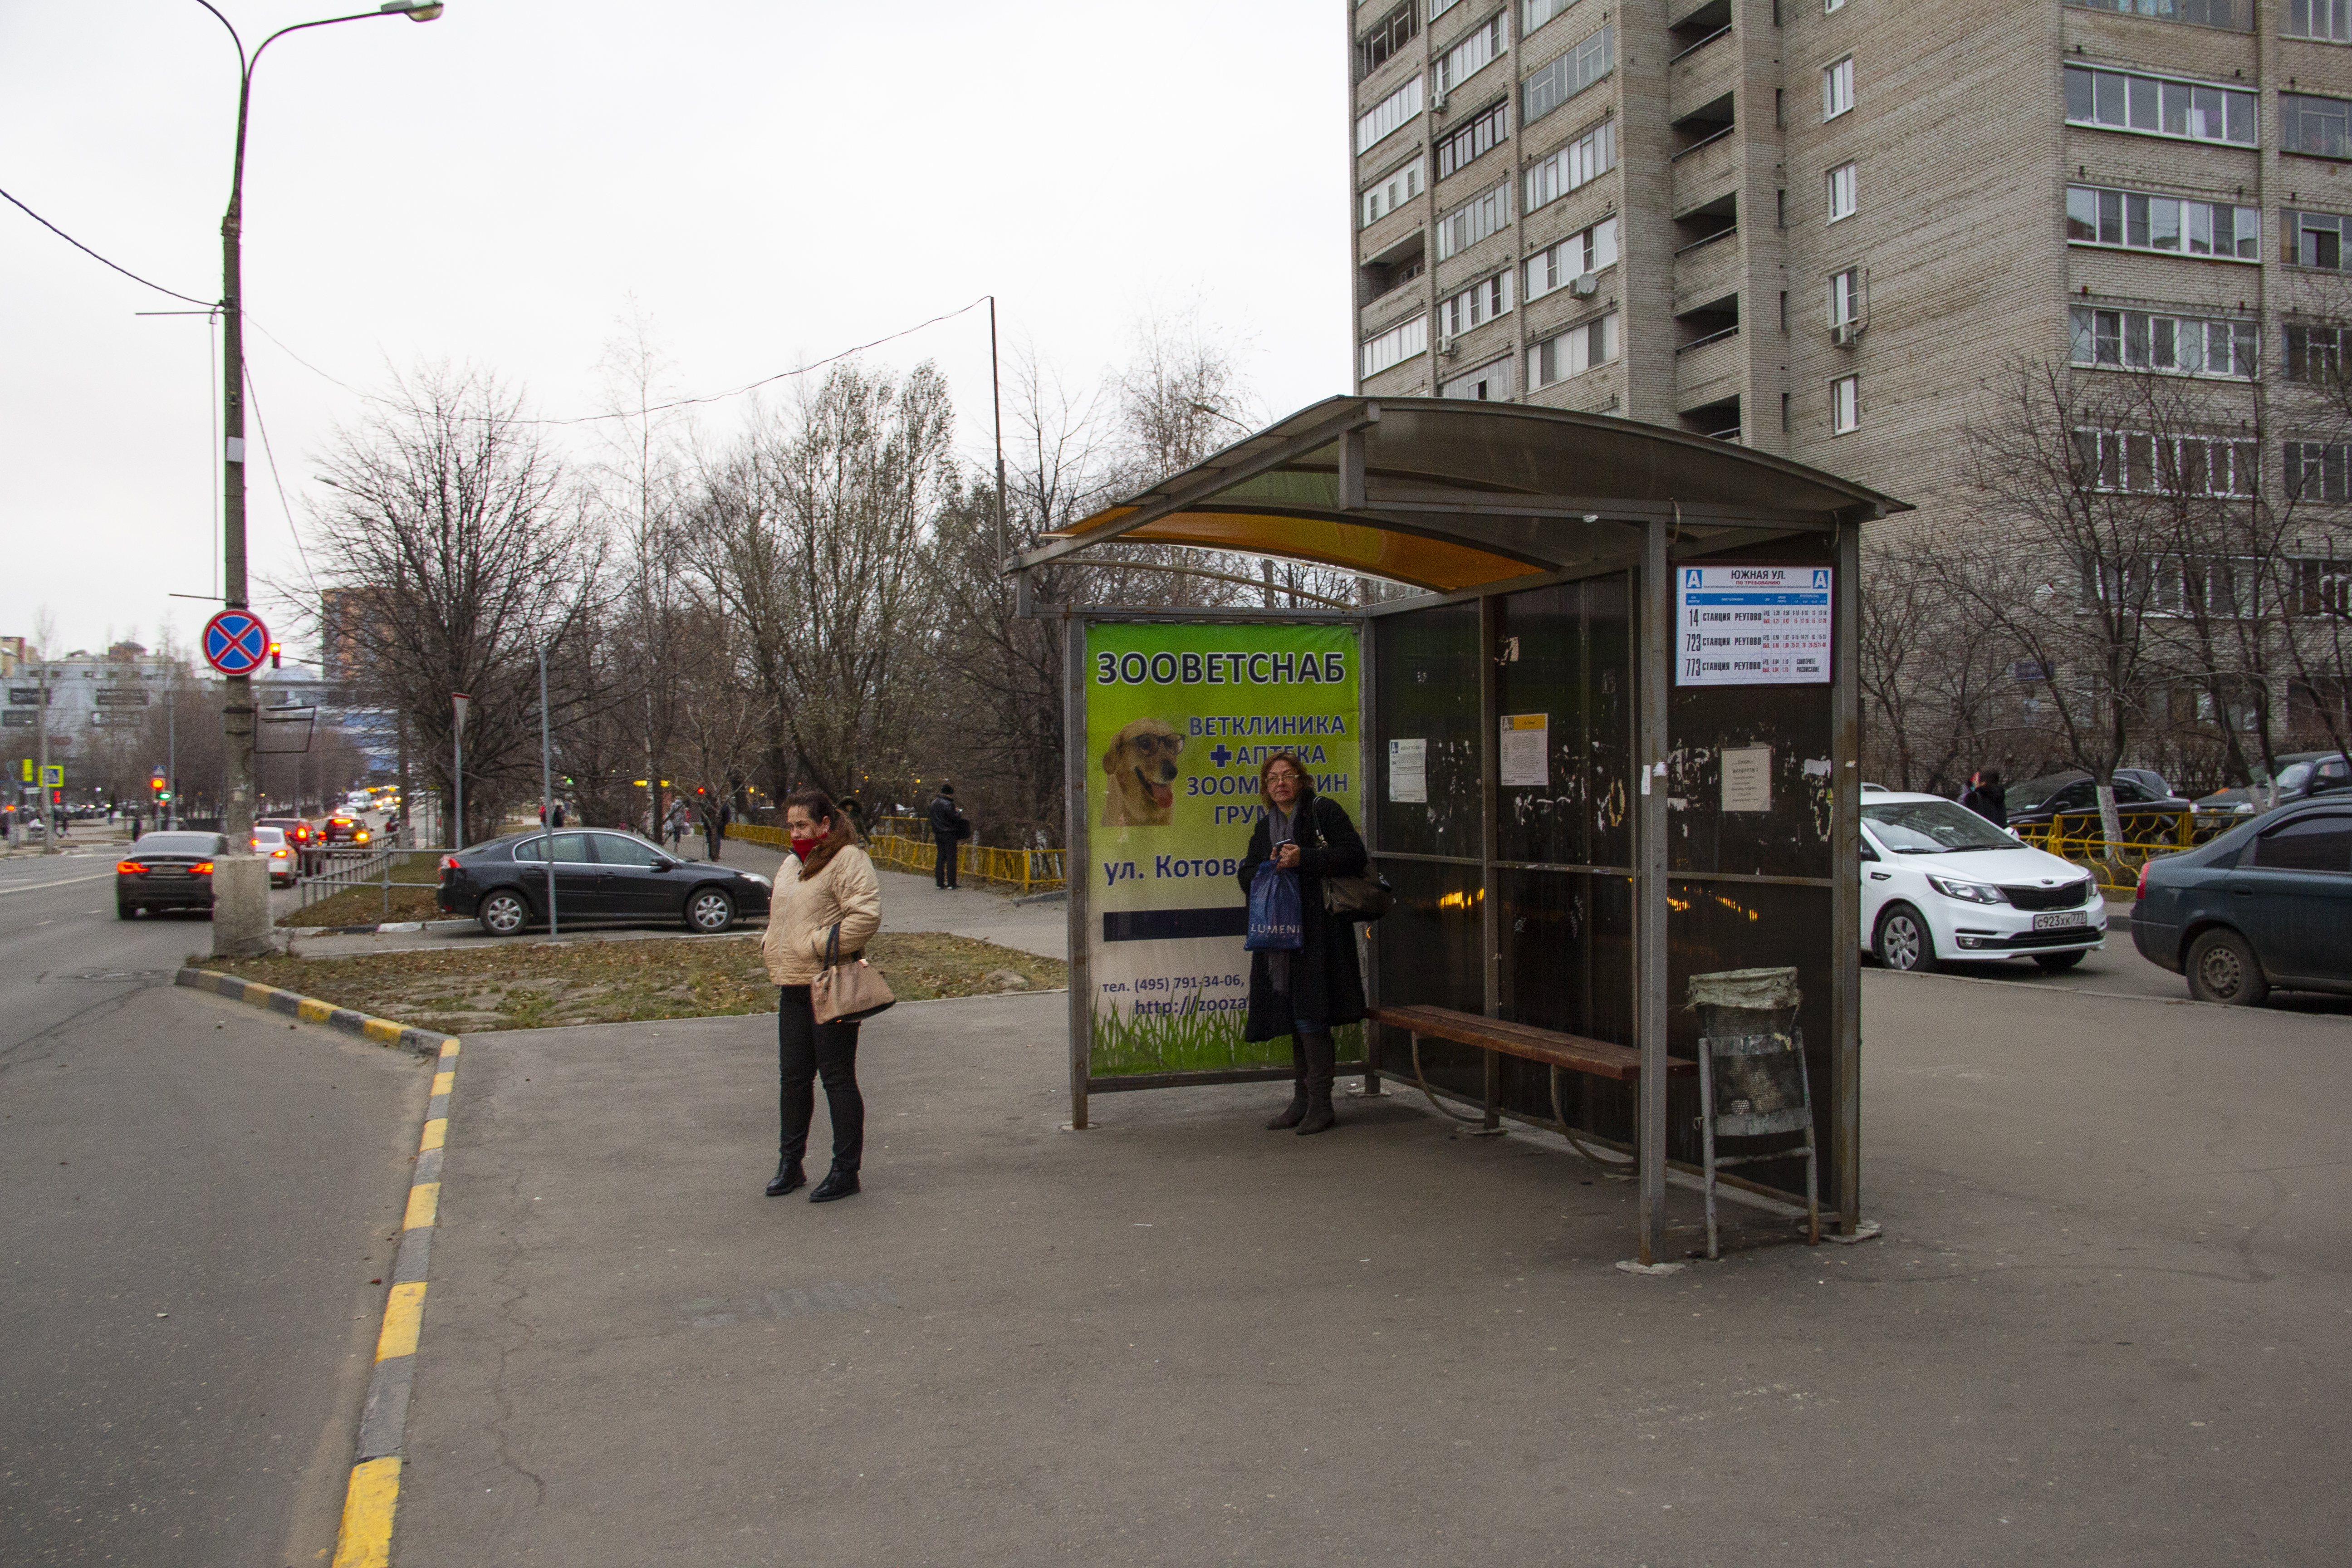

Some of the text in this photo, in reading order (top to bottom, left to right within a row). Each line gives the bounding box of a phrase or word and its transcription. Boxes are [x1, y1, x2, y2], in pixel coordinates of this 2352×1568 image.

[1731, 570, 1786, 579] ЮЖНАЯ УЛ.
[1689, 608, 1762, 627] 14 СТАНЦИЯ РЕУТОВО
[1686, 633, 1761, 652] 723 СТАНЦИЯ РЕУТОВО
[1097, 652, 1345, 685] ЗООВЕТСНАБ
[1686, 658, 1761, 676] 773 СТАНЦИЯ РЕУТОВО
[1189, 715, 1346, 736] ВЕТКЛИНИКА
[1235, 745, 1327, 765] АПКА
[1186, 773, 1348, 796] ЗООМИН
[1103, 862, 1144, 886] ул.
[2071, 912, 2084, 922] 777
[1102, 974, 1244, 994] тел. (495) 791-34-06,
